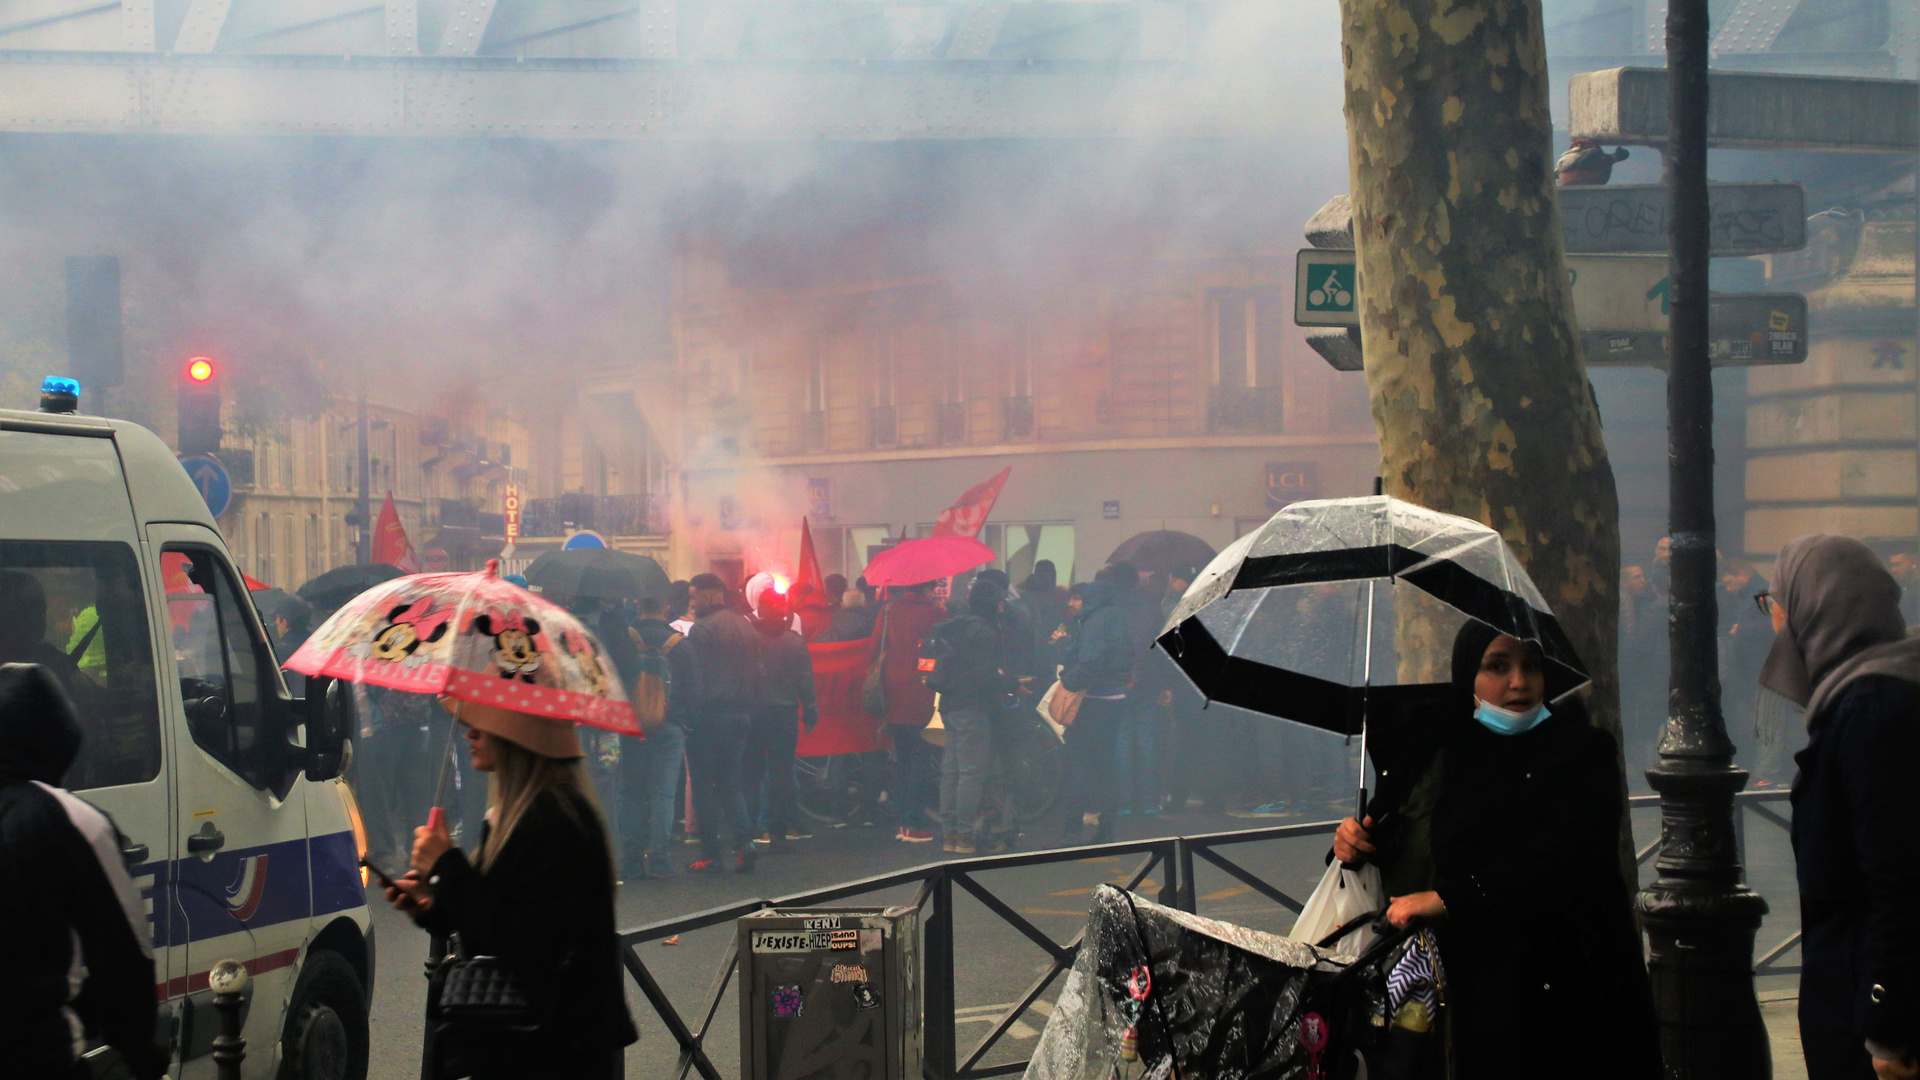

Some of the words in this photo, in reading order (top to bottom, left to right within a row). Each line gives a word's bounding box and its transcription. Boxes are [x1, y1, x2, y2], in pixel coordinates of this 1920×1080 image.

[1269, 472, 1311, 487] LCL
[805, 917, 838, 930] KENY
[831, 941, 856, 949] OUPS!
